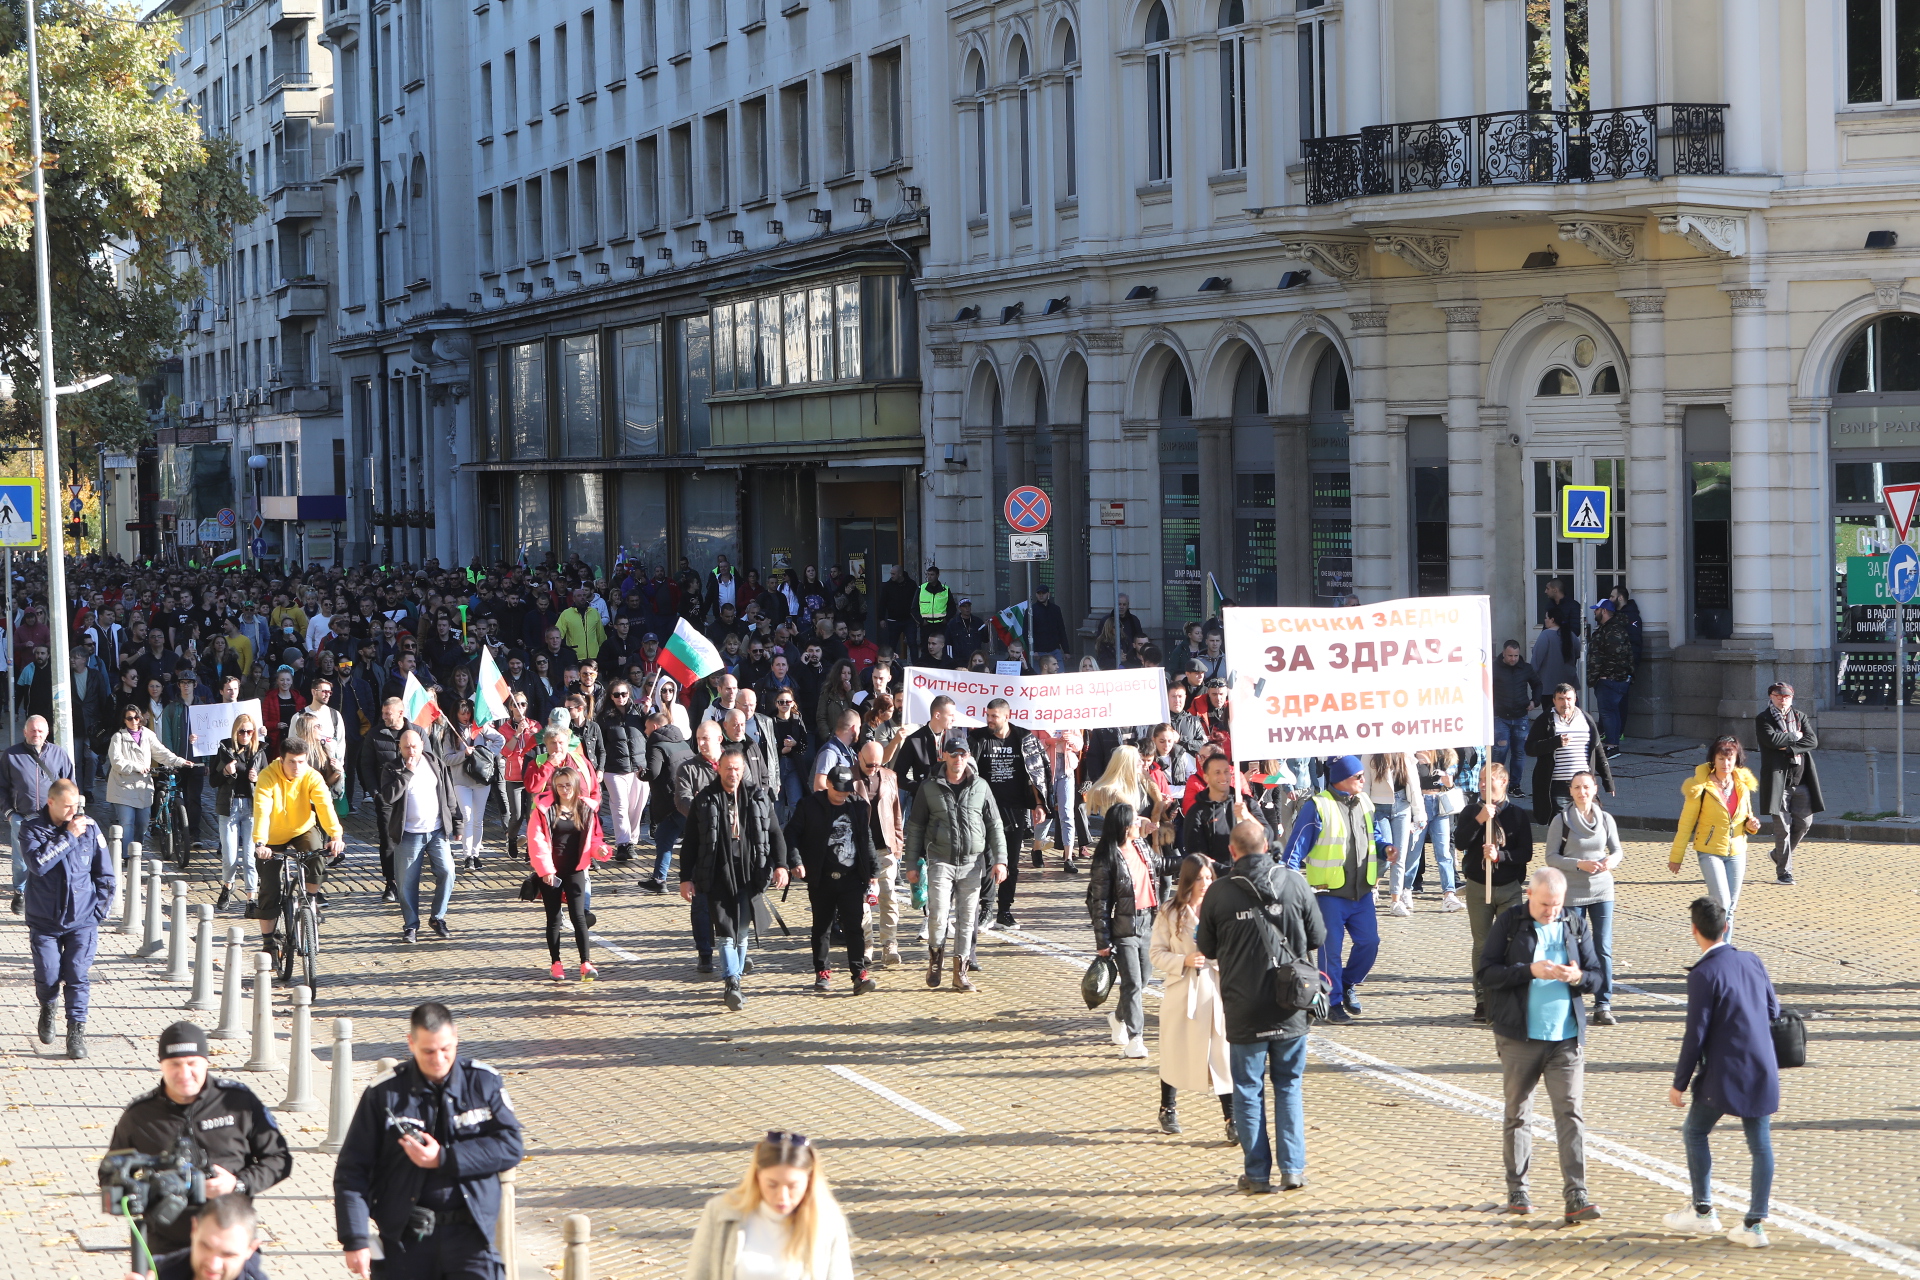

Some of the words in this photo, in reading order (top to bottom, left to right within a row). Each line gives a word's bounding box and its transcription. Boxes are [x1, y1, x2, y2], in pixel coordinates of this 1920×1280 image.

[1838, 421, 1878, 434] BNP
[1161, 442, 1176, 451] BNP
[1867, 562, 1881, 577] ЗА
[1261, 616, 1364, 633] ВСИЧКИ
[1372, 608, 1459, 629] ЗАЕДНО
[1867, 608, 1873, 619] В
[1857, 620, 1887, 632] ОНЛАЙН
[1264, 645, 1315, 673] ЗА
[913, 674, 999, 695] Фитнесът
[1004, 685, 1014, 697] е
[1019, 685, 1060, 700] храм
[1066, 683, 1083, 695] на
[1089, 678, 1157, 696] здравето
[966, 705, 976, 717] а
[1009, 708, 1029, 720] на
[1034, 702, 1112, 723] заразата!
[1265, 689, 1408, 718] ЗДРАВЕТО
[1418, 686, 1464, 706] ИМА
[196, 713, 230, 731] Make
[1268, 724, 1349, 743] НУЖДА
[1356, 722, 1384, 738] ОТ
[1391, 717, 1463, 736] ФИТНЕС
[453, 1107, 493, 1129] POLICE
